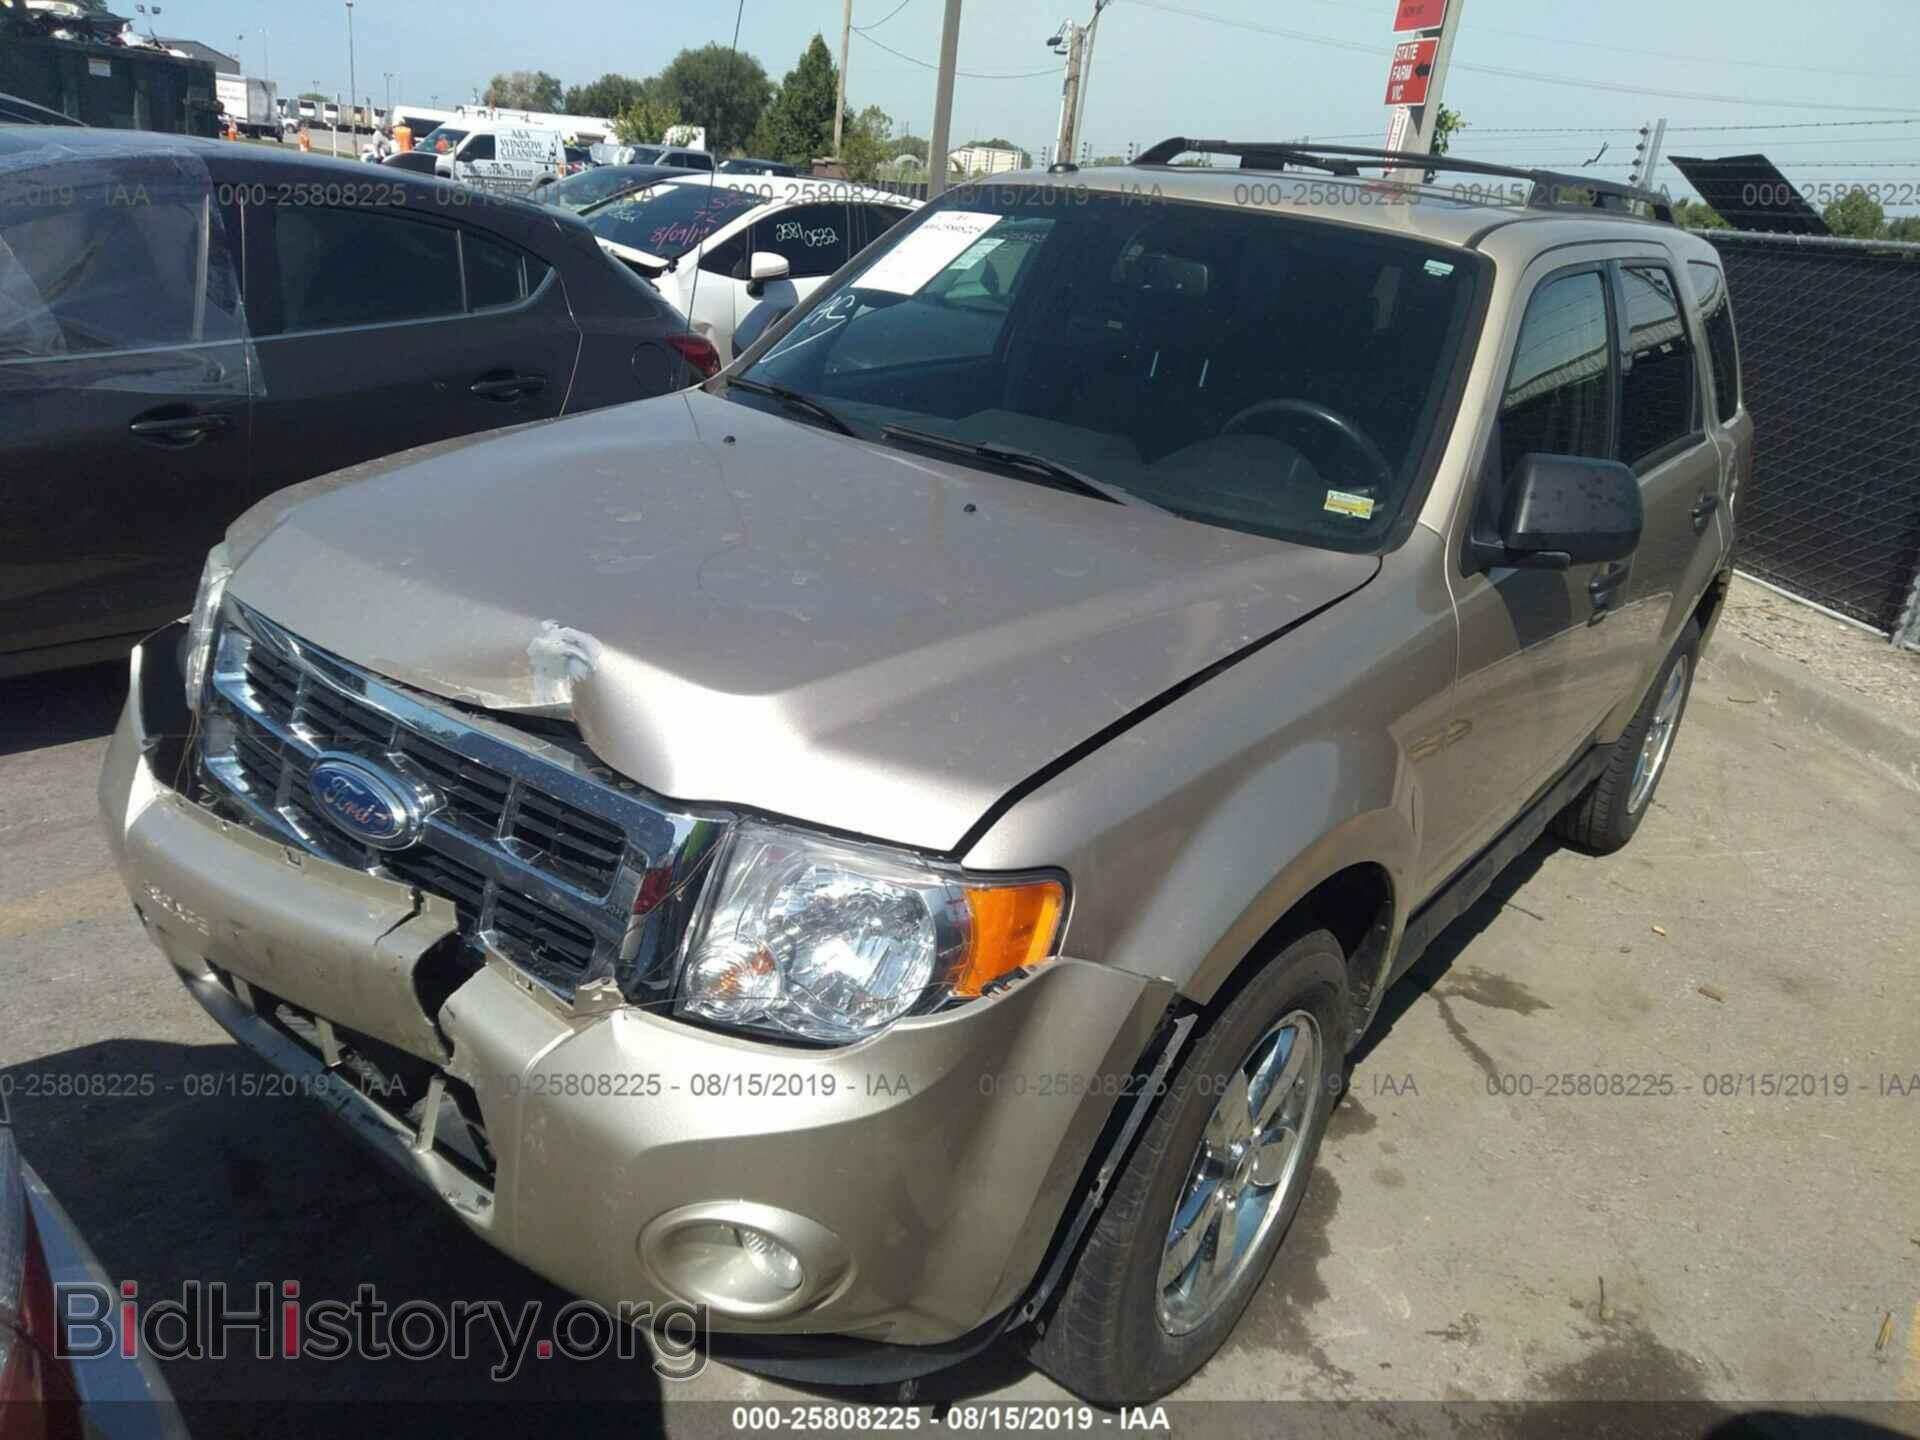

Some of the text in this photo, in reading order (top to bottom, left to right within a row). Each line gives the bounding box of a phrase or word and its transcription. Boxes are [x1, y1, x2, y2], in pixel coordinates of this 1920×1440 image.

[1395, 43, 1419, 61] STATE
[1391, 64, 1413, 81] FARM
[500, 139, 543, 150] WINDOW
[500, 149, 546, 160] CLEANING
[322, 775, 389, 825] Ford
